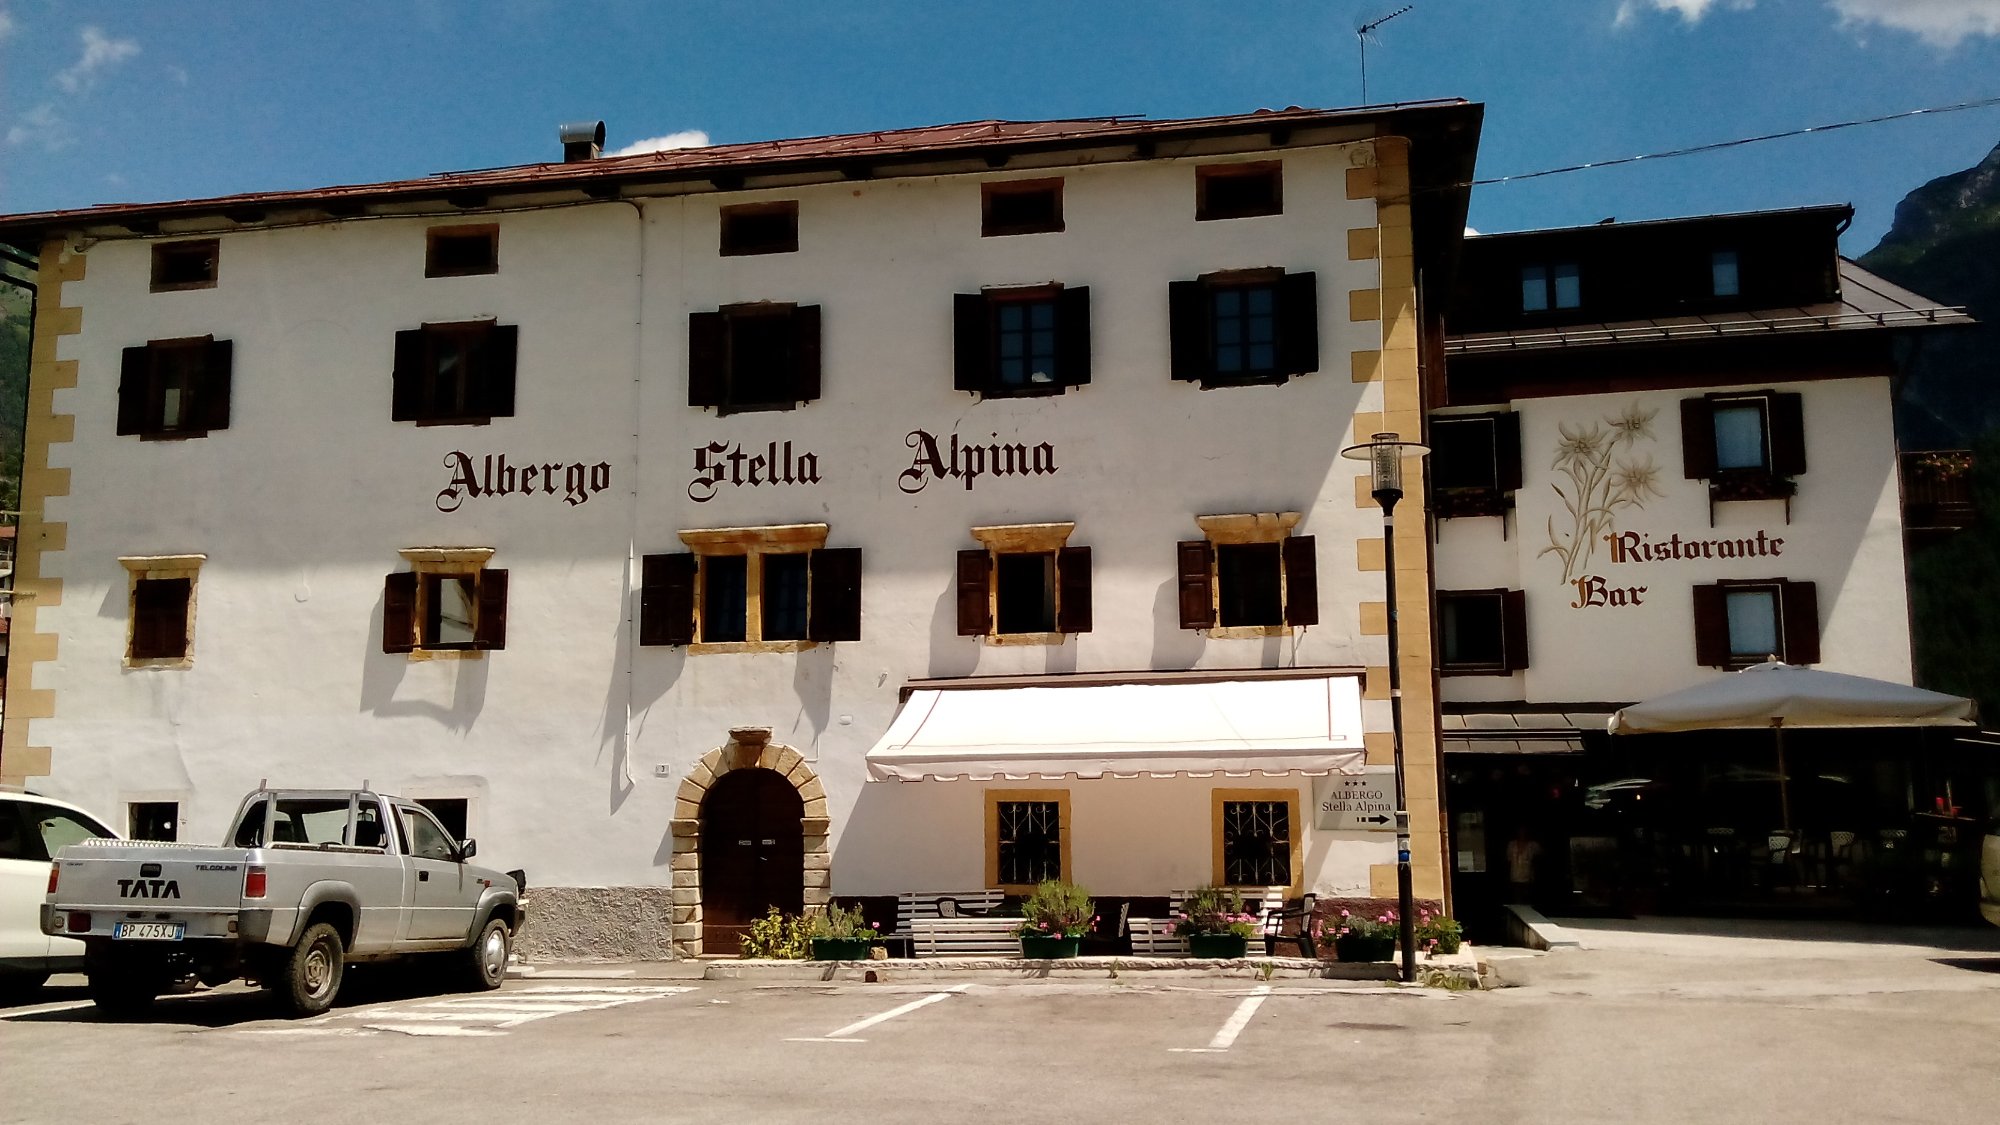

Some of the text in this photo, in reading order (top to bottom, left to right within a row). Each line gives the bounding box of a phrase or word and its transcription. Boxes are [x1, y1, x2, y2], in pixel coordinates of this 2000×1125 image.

[436, 427, 1060, 513] Albergo Stella Alpina
[1603, 529, 1785, 563] Ristorante
[1570, 574, 1648, 609] Bar
[1331, 790, 1383, 800] ALBERGO
[1322, 801, 1391, 814] Stella Alpina
[117, 879, 181, 899] TATA
[121, 924, 176, 938] BP 475XJ
